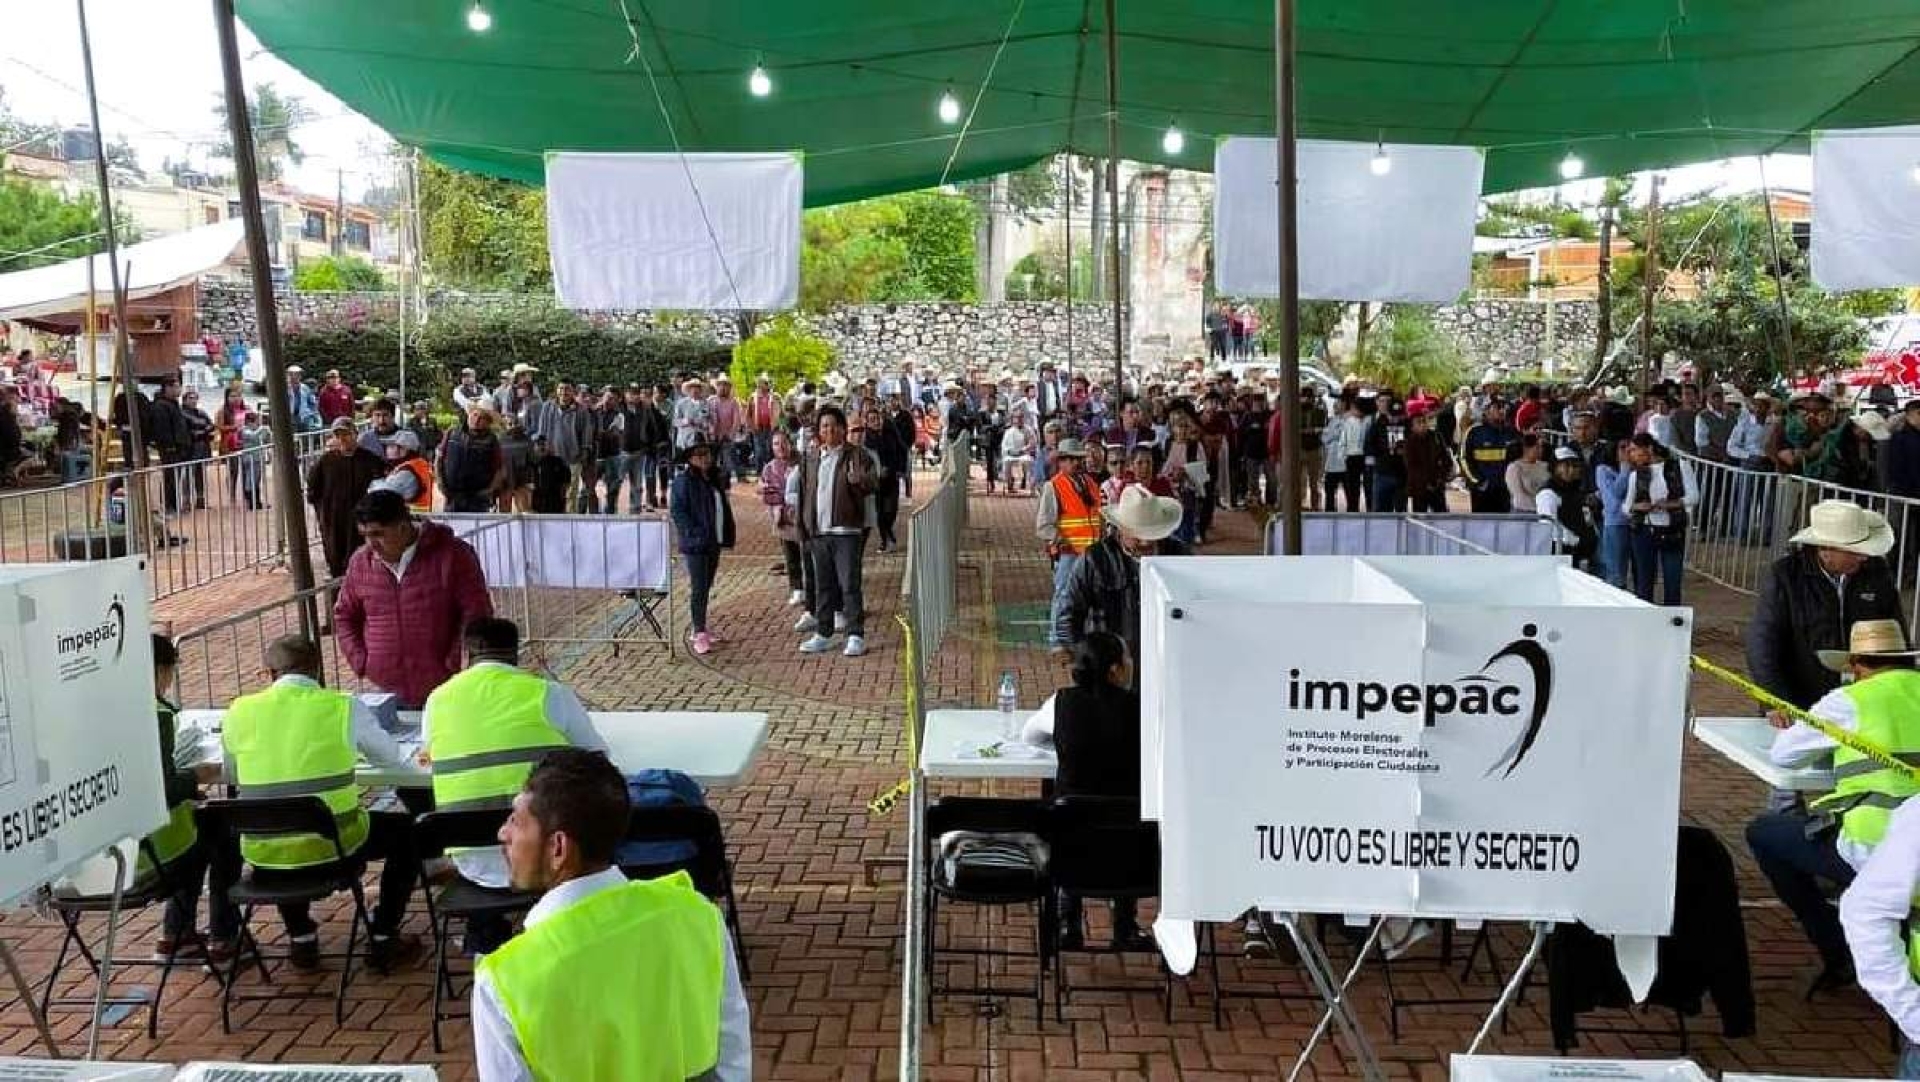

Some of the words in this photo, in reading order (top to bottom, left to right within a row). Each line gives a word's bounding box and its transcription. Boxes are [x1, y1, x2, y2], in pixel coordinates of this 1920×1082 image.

[57, 621, 117, 653] impepac
[1289, 669, 1521, 727] impepac
[1286, 743, 1302, 752] de
[1306, 743, 1359, 754] Procesos
[1363, 745, 1428, 758] Electorales
[1289, 729, 1336, 741] Instituto
[1340, 730, 1402, 743] Morelense
[1285, 759, 1294, 768] y
[1297, 757, 1374, 770] Participación
[1377, 759, 1441, 771] Ciudadana
[2, 813, 23, 851] ES
[24, 793, 60, 842] LIBRE
[60, 788, 68, 824] Y
[69, 765, 118, 817] SECRETO
[1255, 825, 1285, 862] TU
[1289, 826, 1351, 865] VOTO
[1357, 828, 1386, 865] ES
[1391, 830, 1451, 867] LIBRE
[1455, 831, 1472, 868] Y
[1474, 831, 1580, 872] SECRETO
